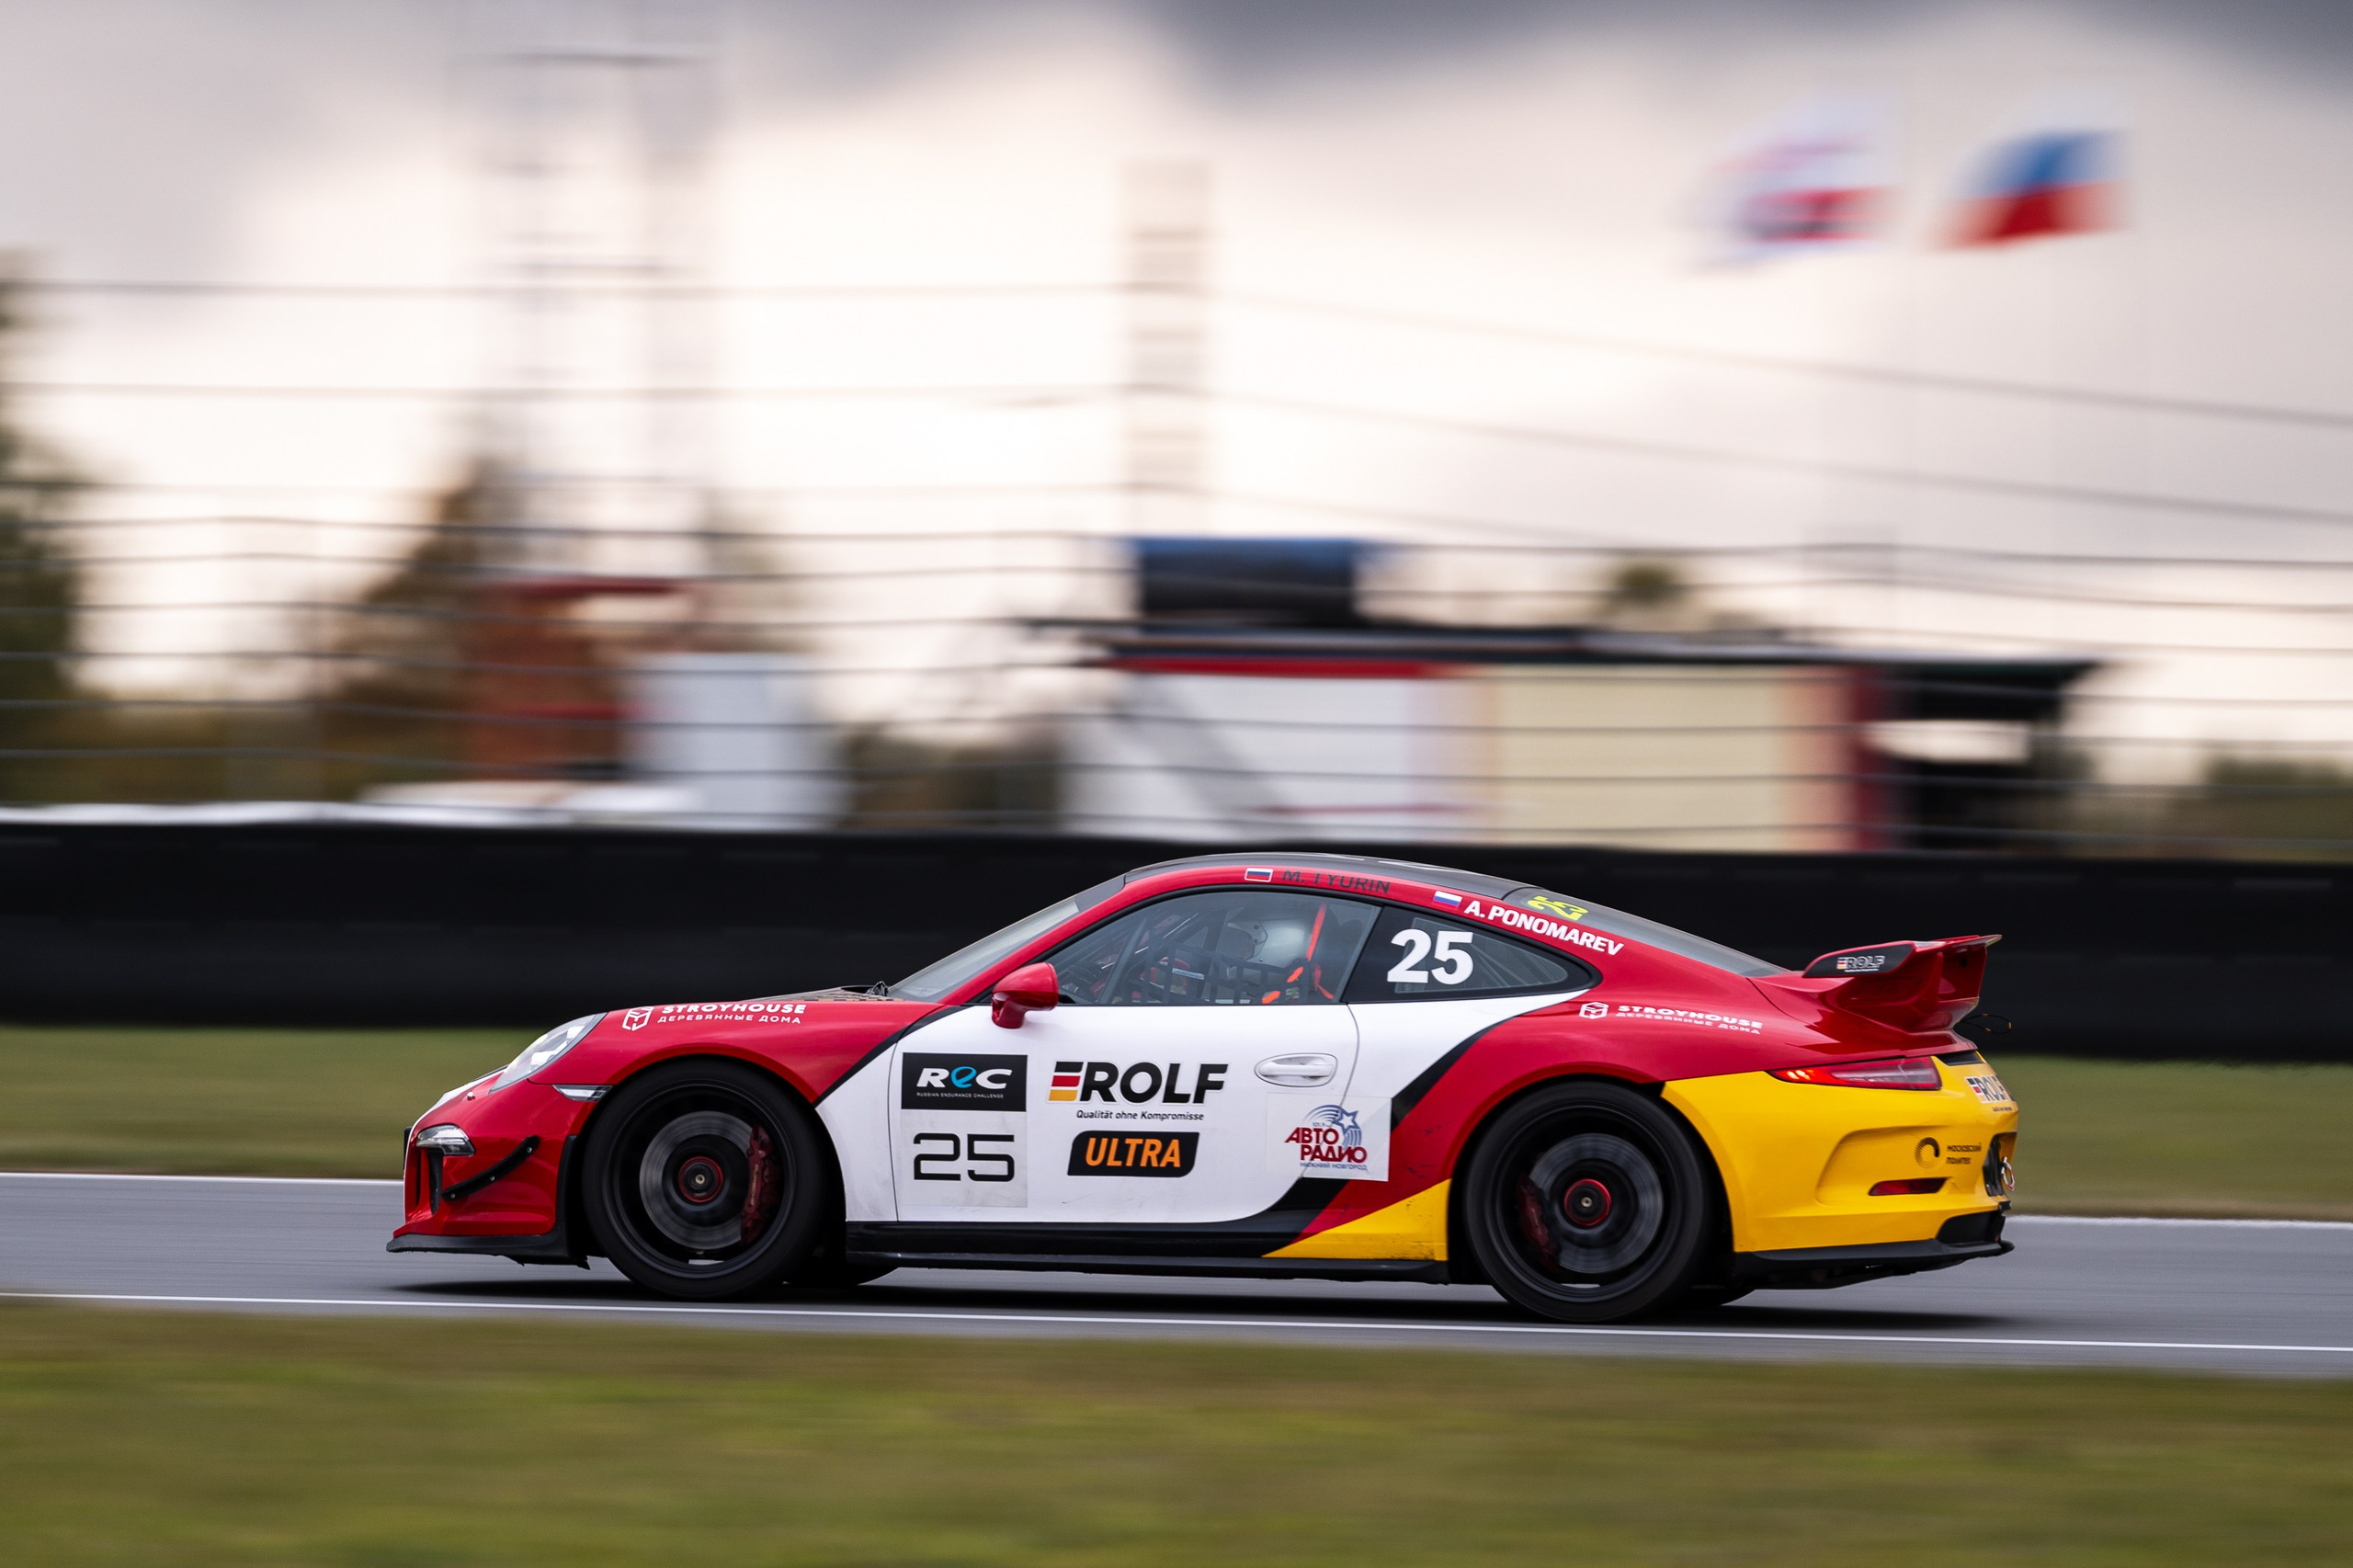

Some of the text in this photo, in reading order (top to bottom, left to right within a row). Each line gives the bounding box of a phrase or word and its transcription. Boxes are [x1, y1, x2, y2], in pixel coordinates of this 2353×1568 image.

[1282, 869, 1306, 883] M.
[1464, 900, 1625, 956] A. PONOMAREV
[1386, 928, 1474, 985] 25
[1847, 955, 1886, 970] ROLF
[661, 1003, 807, 1014] STROYHOUSE
[1617, 1005, 1763, 1028] STROYHOUSE
[657, 1014, 801, 1024] ДЕРЕВЯННЫЕ ДОМА
[1717, 1024, 1761, 1035] ДОМА
[1079, 1062, 1229, 1104] ROLF
[1076, 1109, 1205, 1121] Qualität ohne Kompromisse
[1284, 1127, 1339, 1145] АВТО
[913, 1131, 1016, 1183] 25
[1086, 1137, 1181, 1168] ULTRA
[1301, 1143, 1368, 1164] РАДИО
